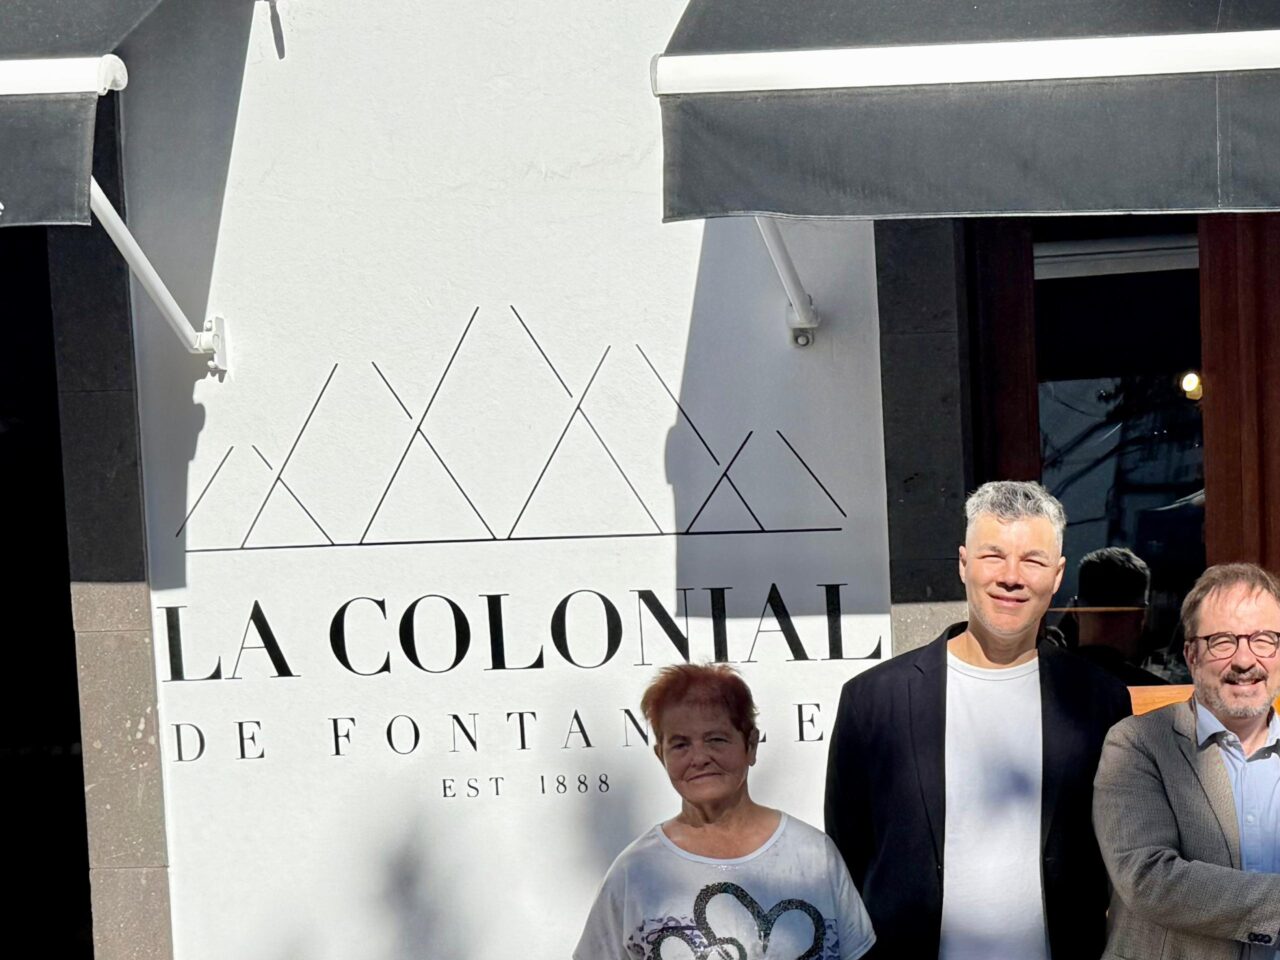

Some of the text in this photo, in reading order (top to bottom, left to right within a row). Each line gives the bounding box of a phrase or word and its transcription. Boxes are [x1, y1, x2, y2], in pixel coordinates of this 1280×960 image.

[156, 583, 882, 682] LA COLONIAL
[171, 703, 824, 762] DE FONTANE
[442, 773, 610, 798] EST 1888
